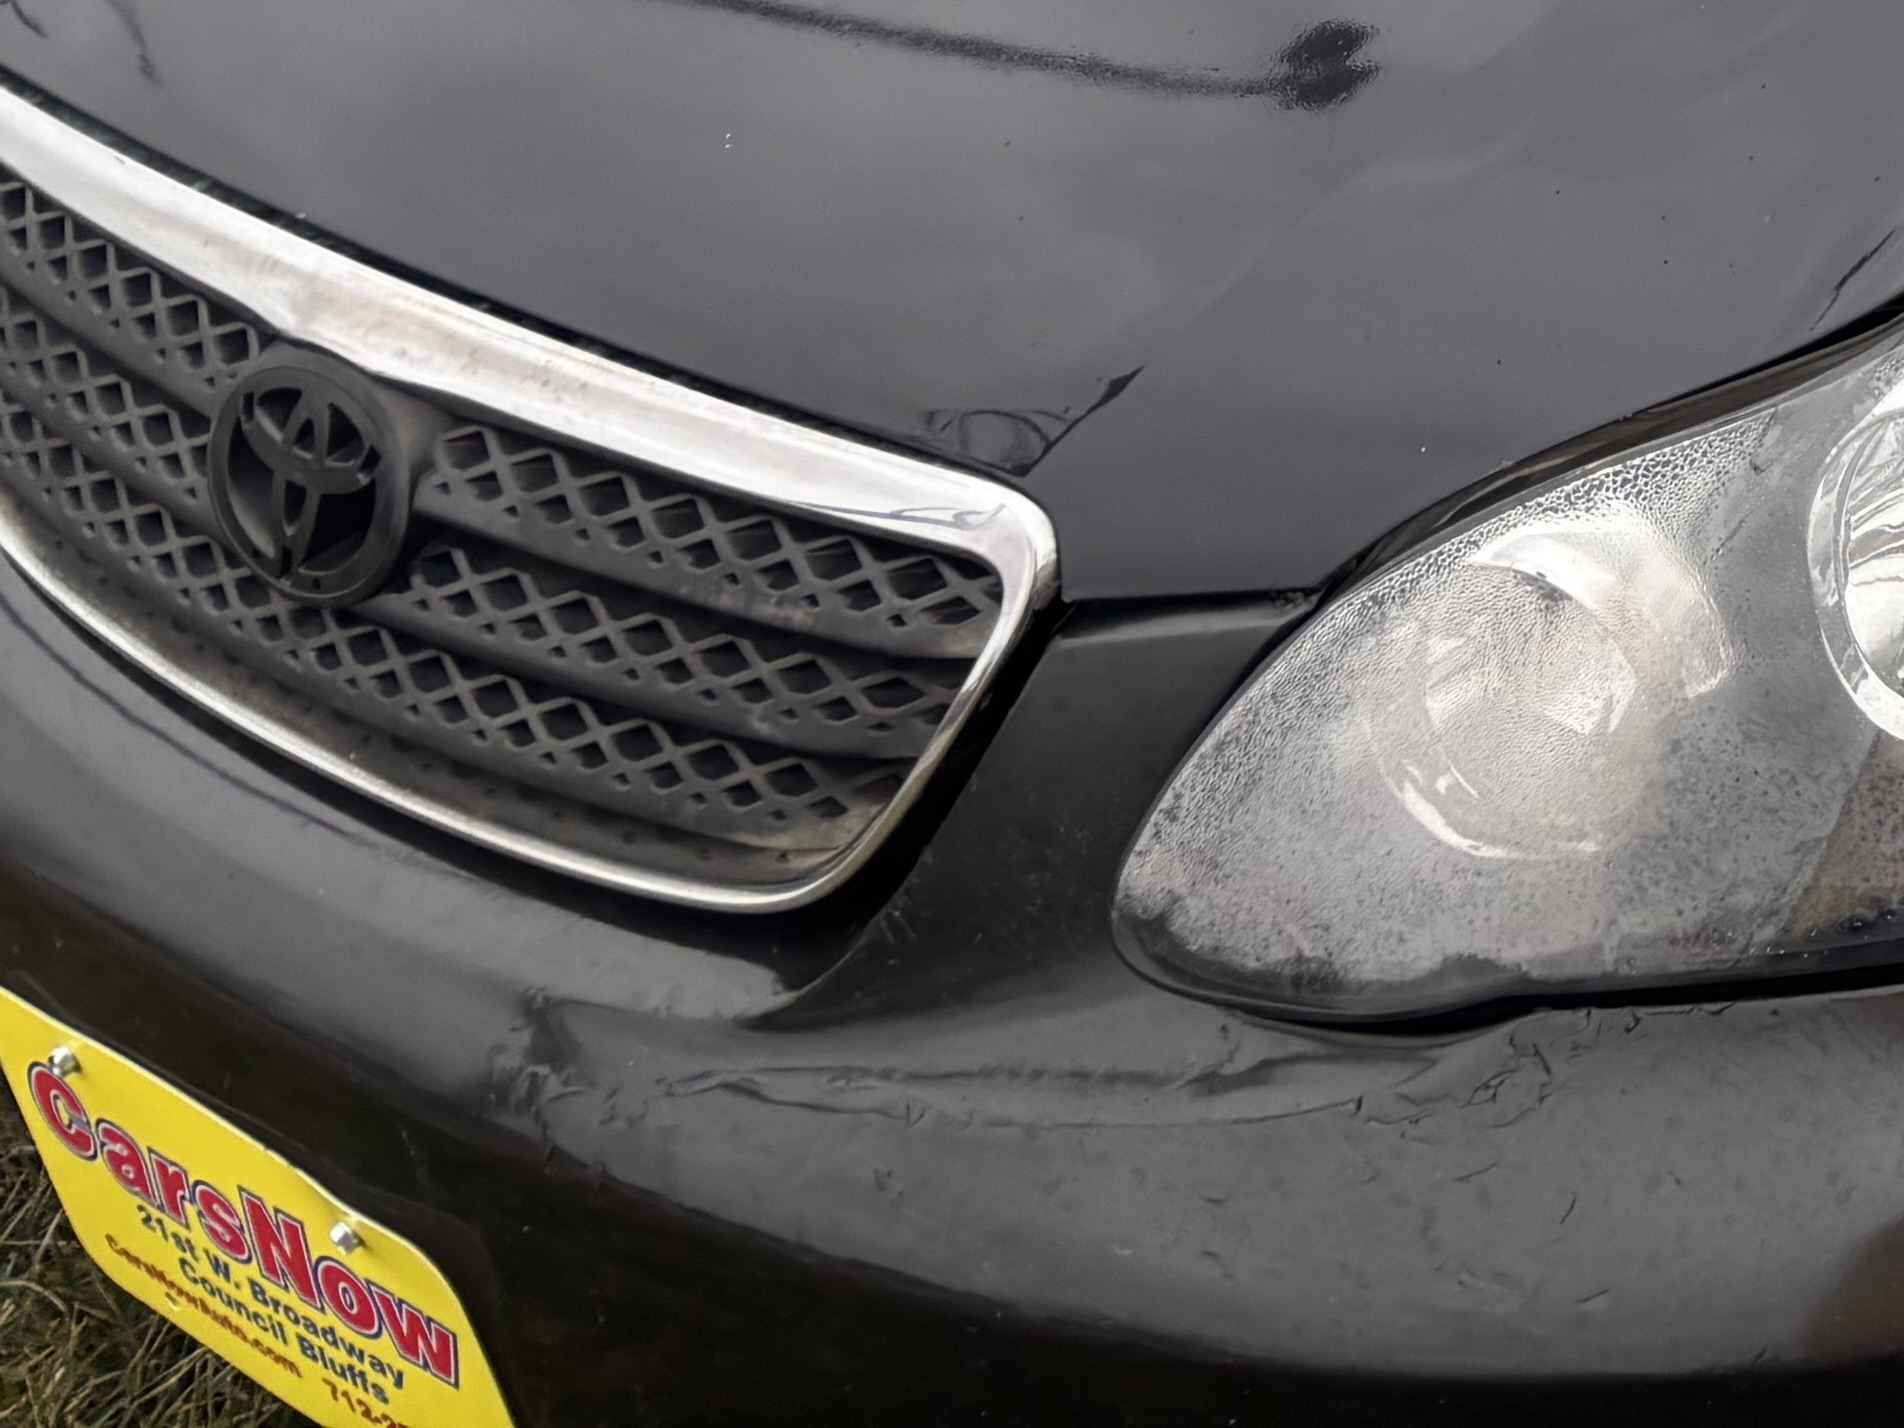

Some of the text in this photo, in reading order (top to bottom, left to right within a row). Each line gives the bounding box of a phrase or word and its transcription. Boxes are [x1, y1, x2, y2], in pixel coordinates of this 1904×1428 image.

[27, 1061, 460, 1390] CarsNow
[136, 1204, 404, 1390] 21st W. Broadway
[178, 1256, 390, 1405] Council Bluffs
